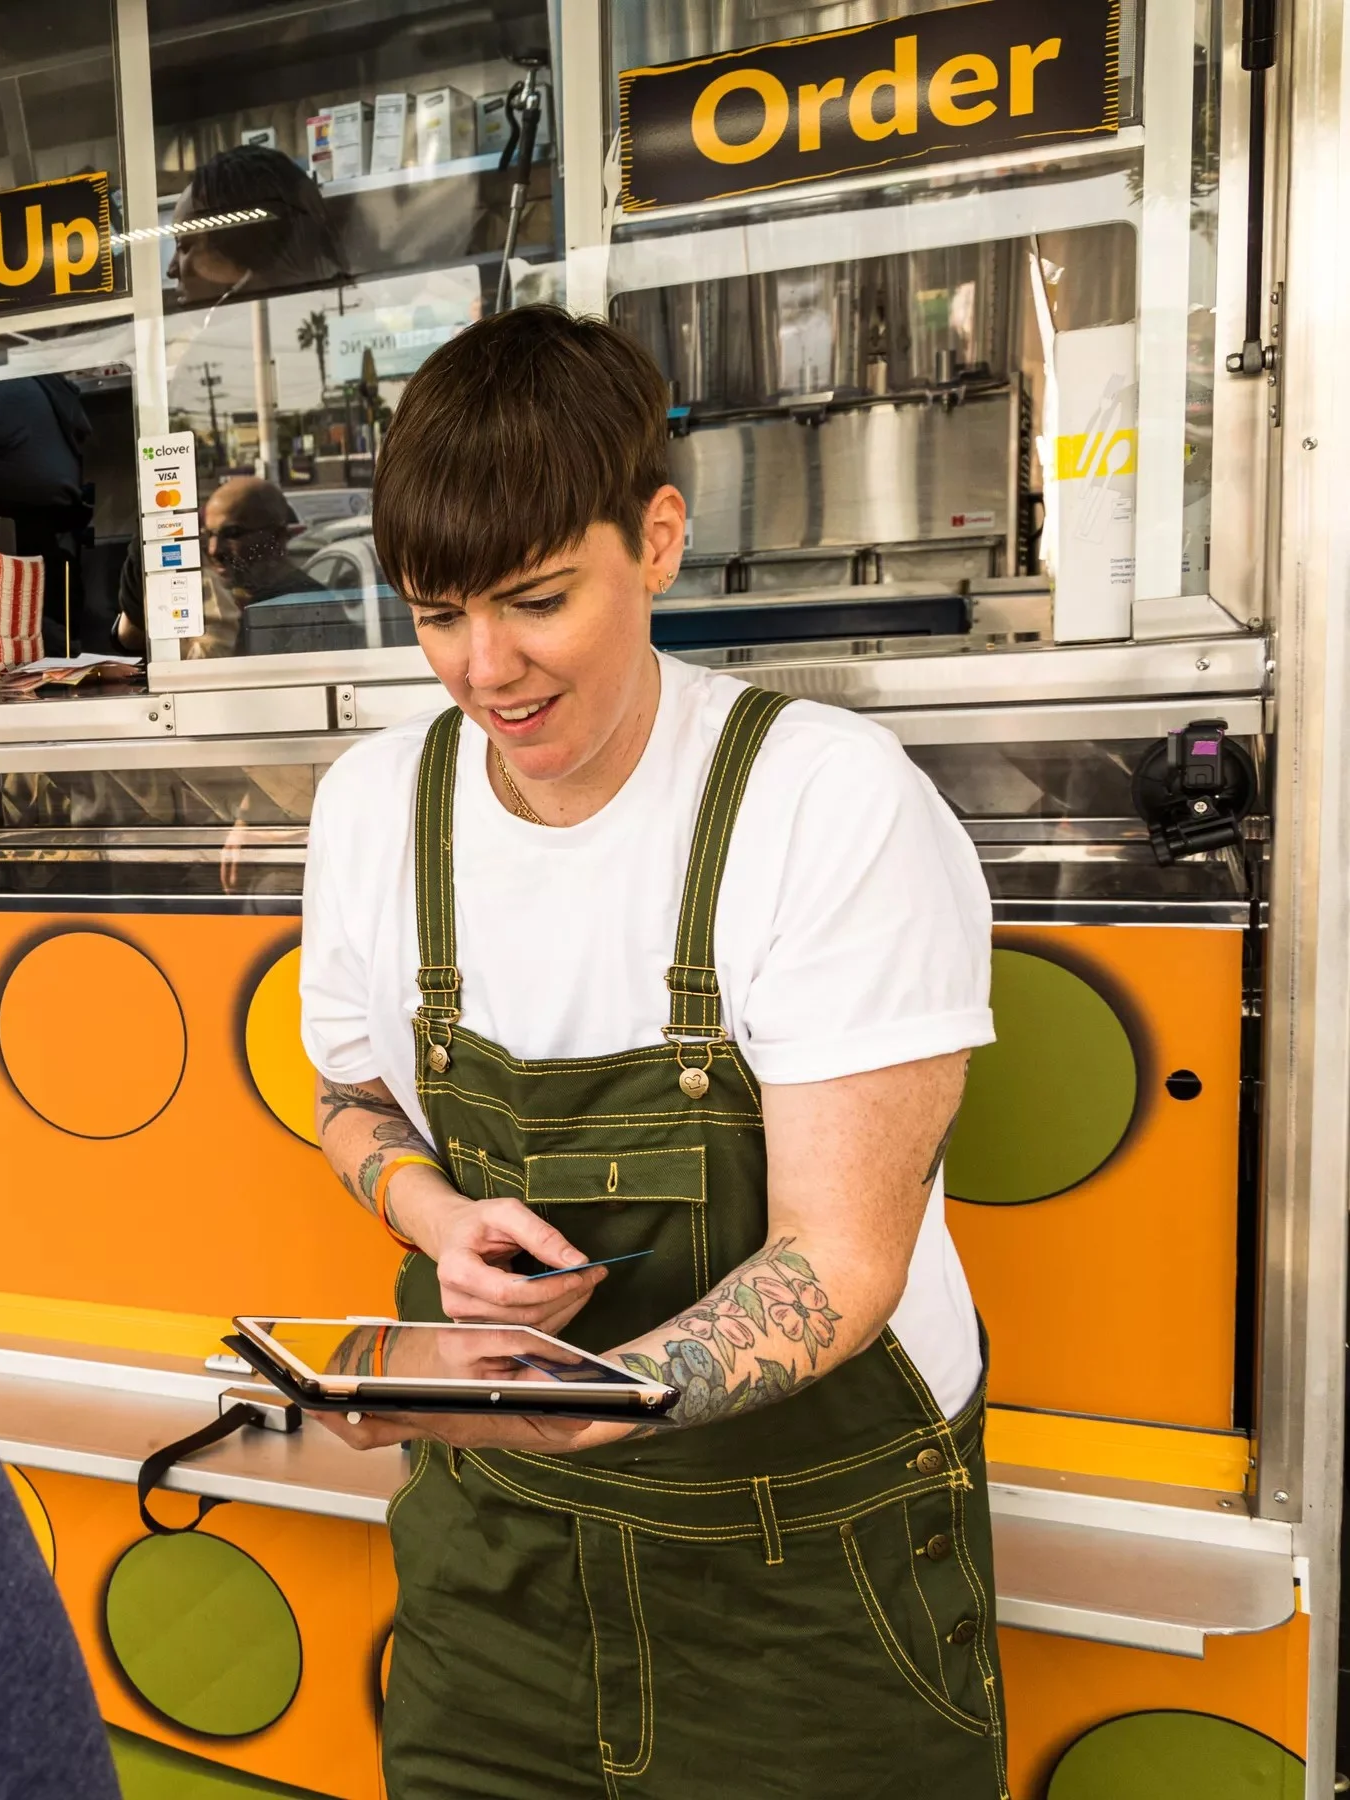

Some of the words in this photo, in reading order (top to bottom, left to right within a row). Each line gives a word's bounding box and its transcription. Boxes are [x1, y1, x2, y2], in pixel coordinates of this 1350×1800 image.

[691, 34, 1062, 165] Order
[155, 445, 190, 457] clover
[158, 472, 178, 481] VISA
